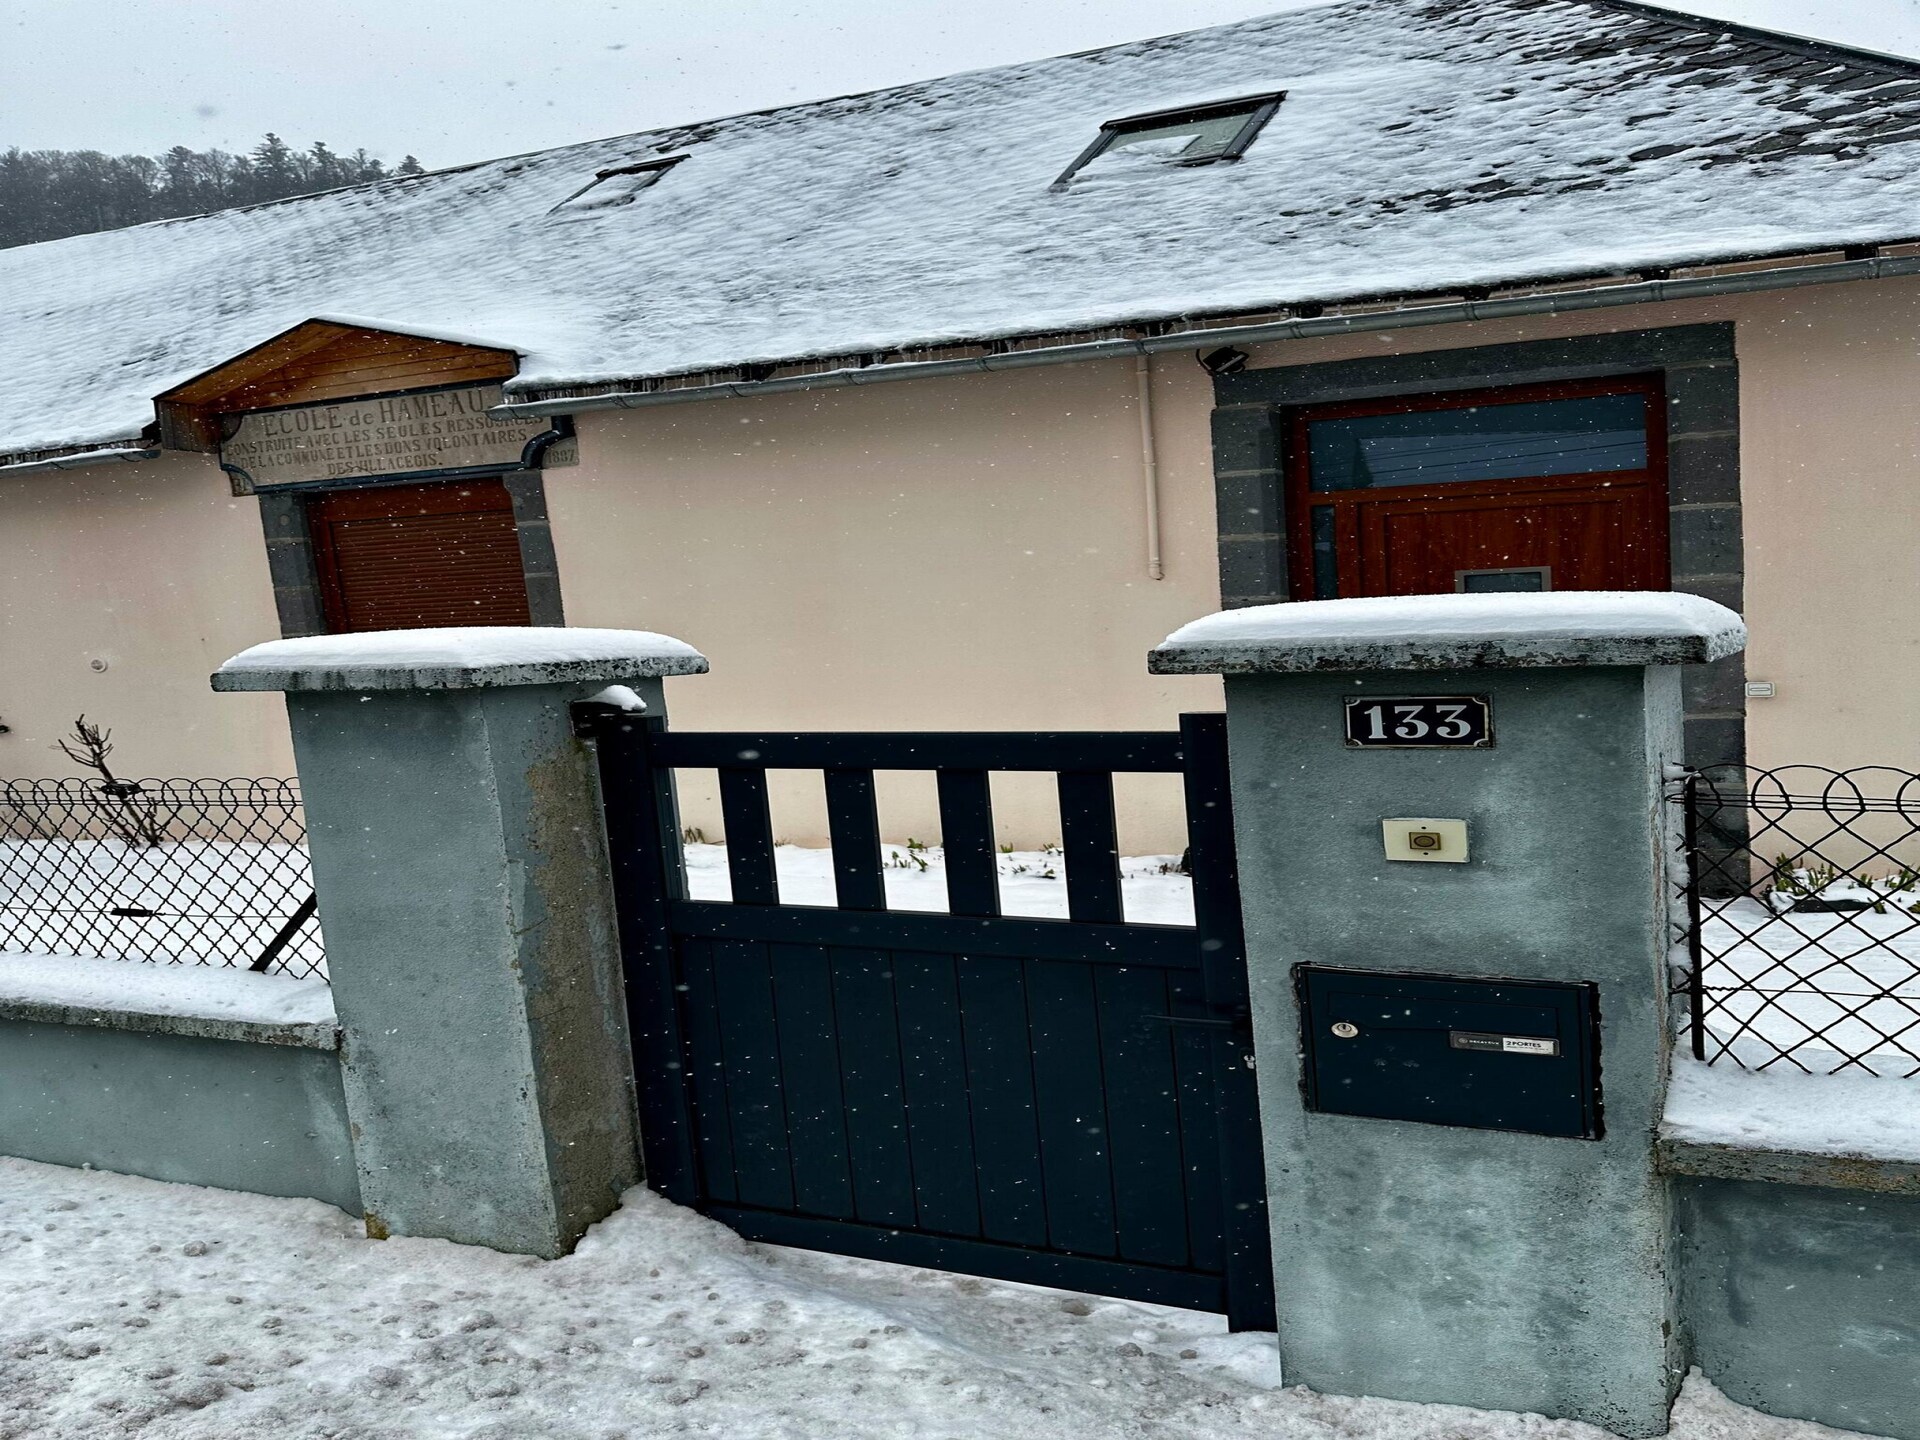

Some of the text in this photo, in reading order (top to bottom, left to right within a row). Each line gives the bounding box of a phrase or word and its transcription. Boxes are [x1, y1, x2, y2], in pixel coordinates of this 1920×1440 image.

[262, 390, 484, 437] ECOLE de HAMEAU
[226, 435, 301, 456] CONSTRUITE
[306, 432, 340, 448] AVEC
[344, 429, 370, 444] LES
[376, 421, 442, 440] SEULES
[357, 443, 382, 457] LES
[385, 440, 421, 454] DONS
[426, 429, 527, 450] VOLONTAIRES
[1364, 704, 1472, 739] 133
